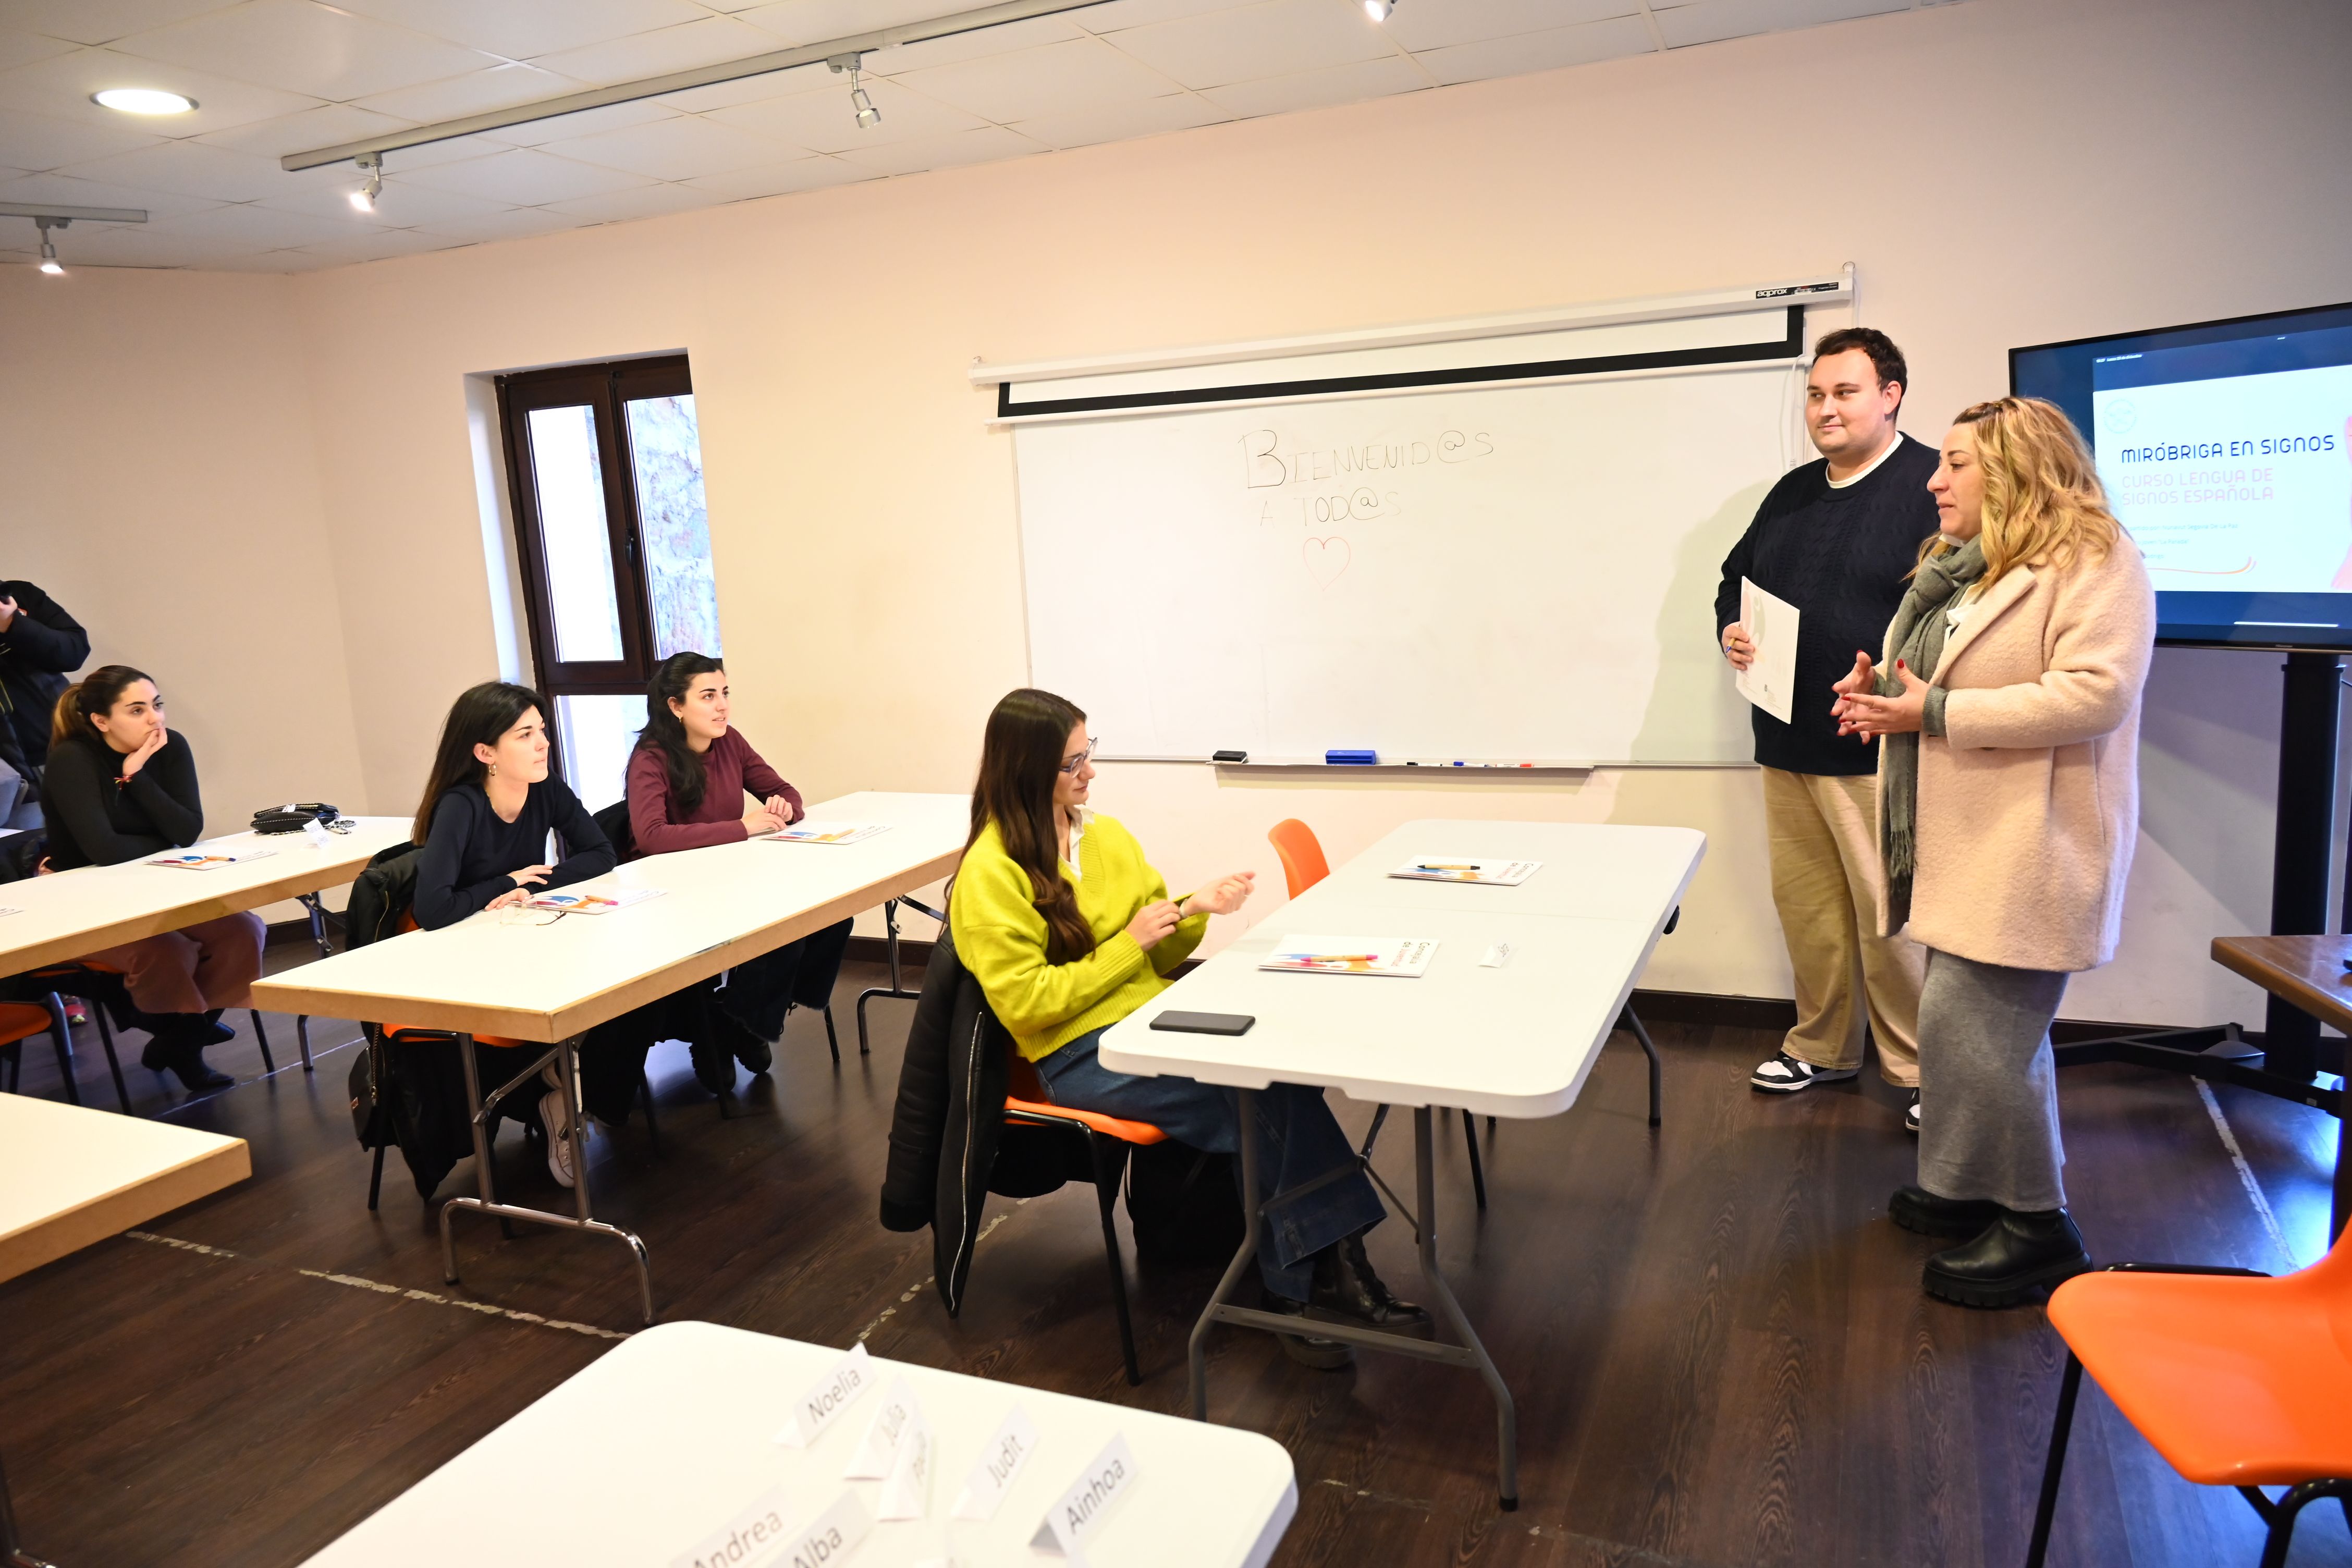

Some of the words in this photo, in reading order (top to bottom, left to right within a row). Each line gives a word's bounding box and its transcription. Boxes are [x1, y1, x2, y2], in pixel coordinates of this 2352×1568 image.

[2122, 442, 2223, 463] MIRÓBRIGA
[2231, 441, 2253, 456] EN
[2261, 435, 2334, 455] SIGNOS
[2122, 473, 2174, 488] CURSO
[2179, 469, 2245, 486] LENGUA
[2252, 468, 2273, 482] DE
[2122, 491, 2178, 506] SIGNOS
[2184, 484, 2273, 503] ESPAÑOLA
[1260, 500, 1276, 529] A
[1294, 487, 1402, 526] TOD@S
[809, 1369, 861, 1424] Noelia
[987, 1434, 1023, 1488] Judit
[1067, 1459, 1125, 1535] Ainhoa
[694, 1511, 782, 1568] ndrea
